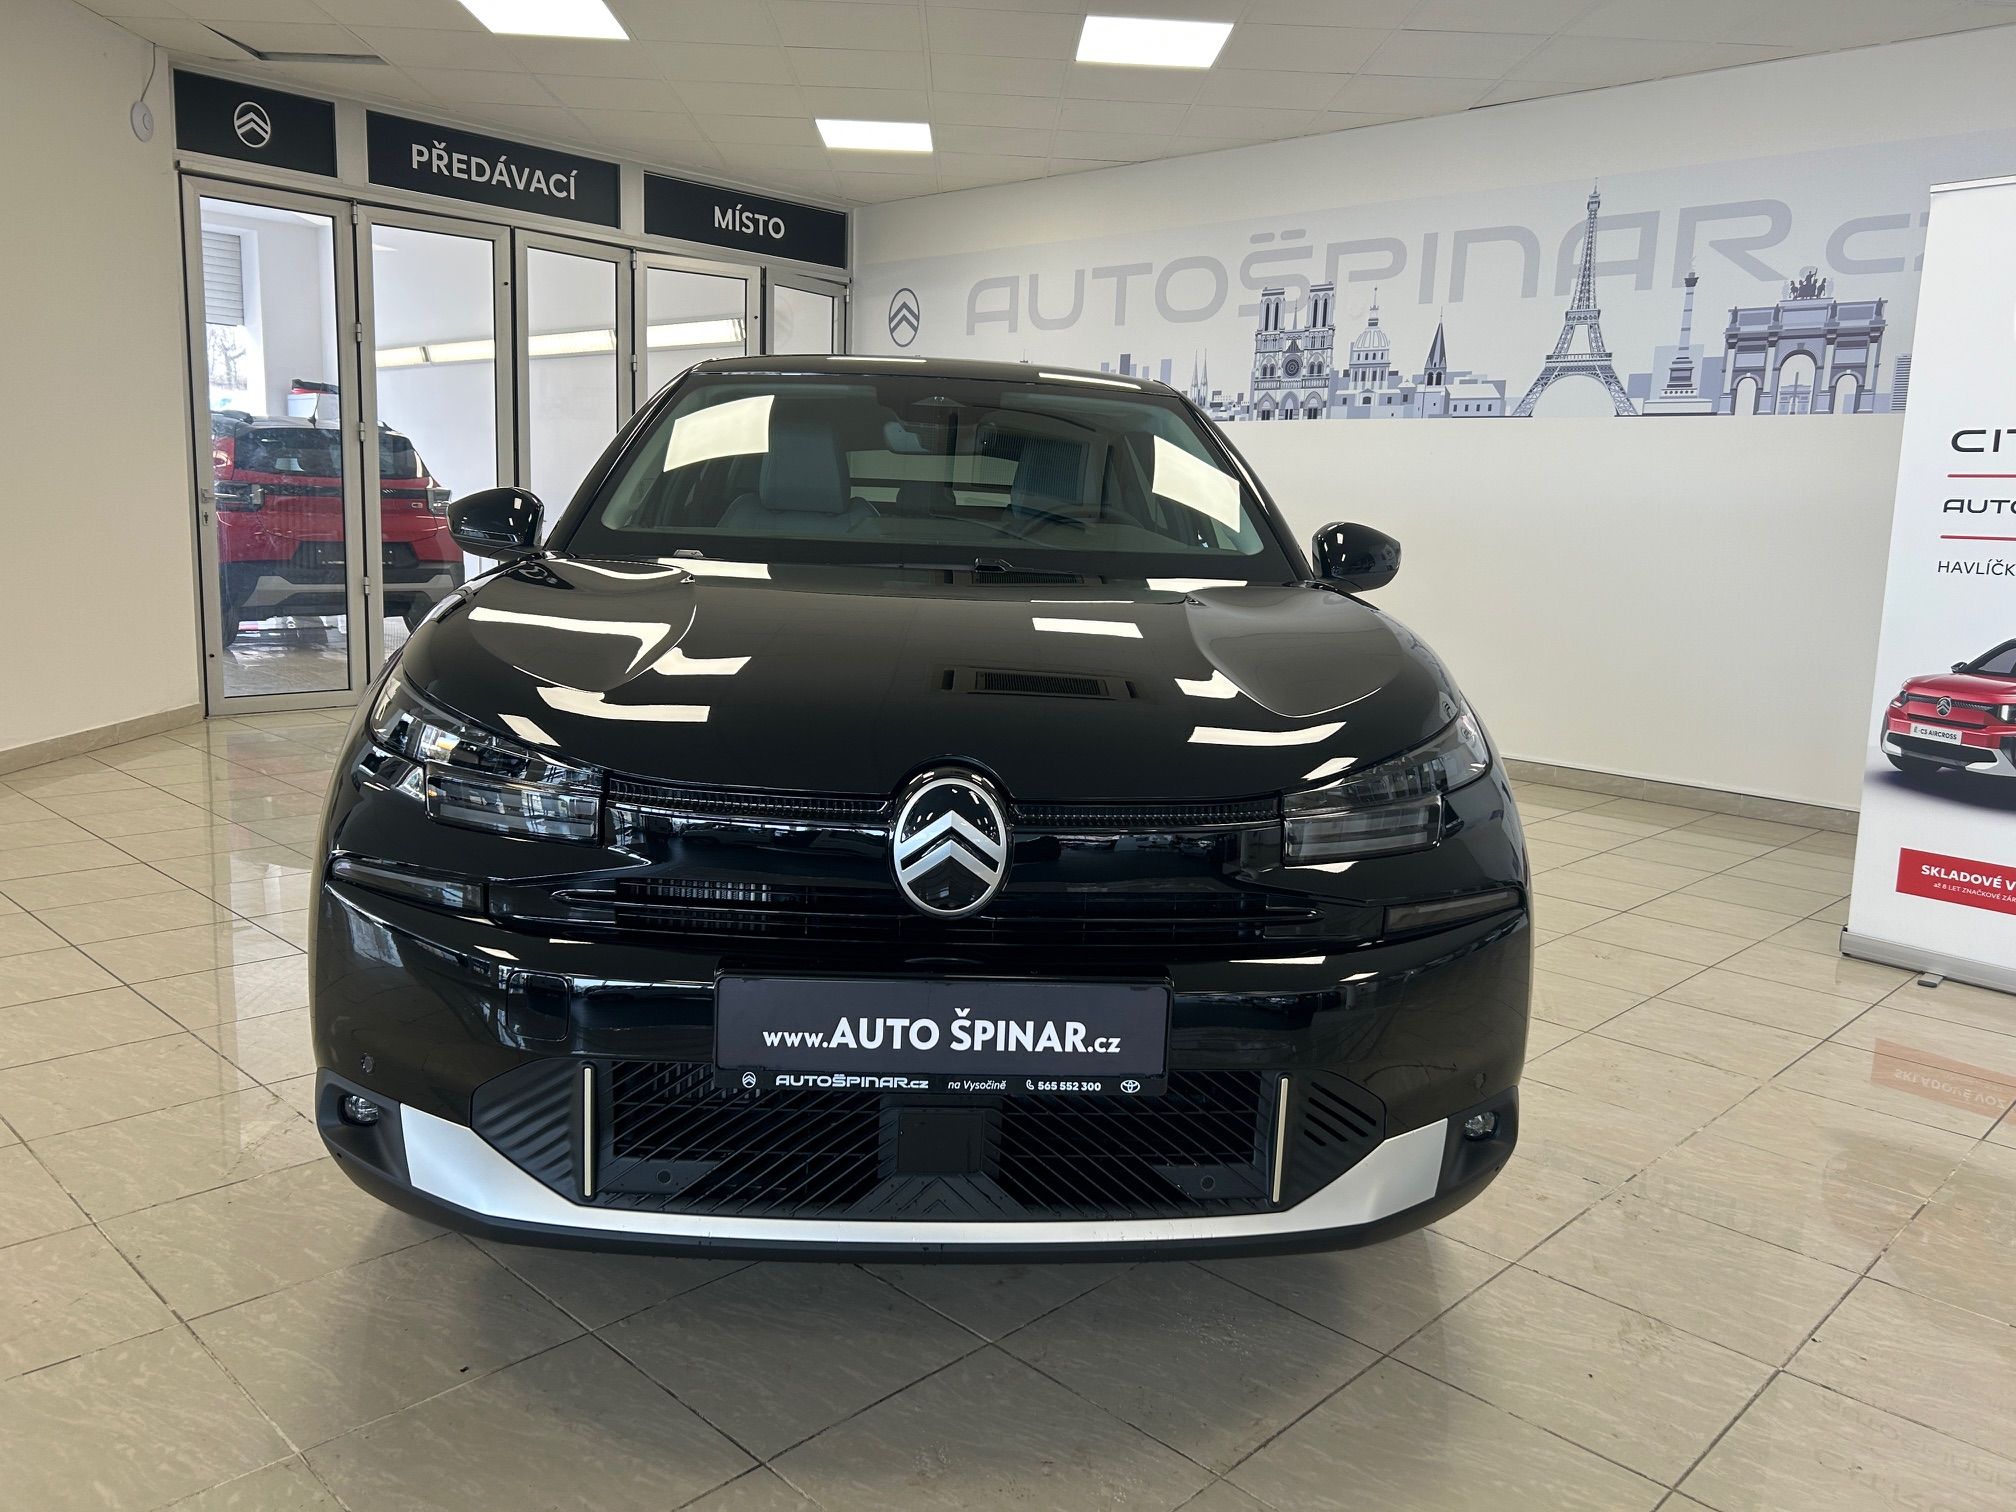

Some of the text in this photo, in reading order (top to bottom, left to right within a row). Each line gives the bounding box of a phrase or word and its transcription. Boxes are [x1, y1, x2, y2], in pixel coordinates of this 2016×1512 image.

[411, 140, 786, 239] PŘEDÁVACÍ MÍSTO
[1928, 730, 1957, 740] AIRCROSS
[1921, 864, 2003, 889] SKLADOVÉ
[1961, 887, 2001, 899] ZNAČKOVÉ
[763, 1008, 1121, 1054] www.AUTO ŠPINAR.cz
[948, 1081, 961, 1090] na
[963, 1079, 1007, 1092] Vysočině
[1037, 1081, 1057, 1091] 565
[1059, 1081, 1079, 1091] 552
[1081, 1081, 1102, 1092] 300
